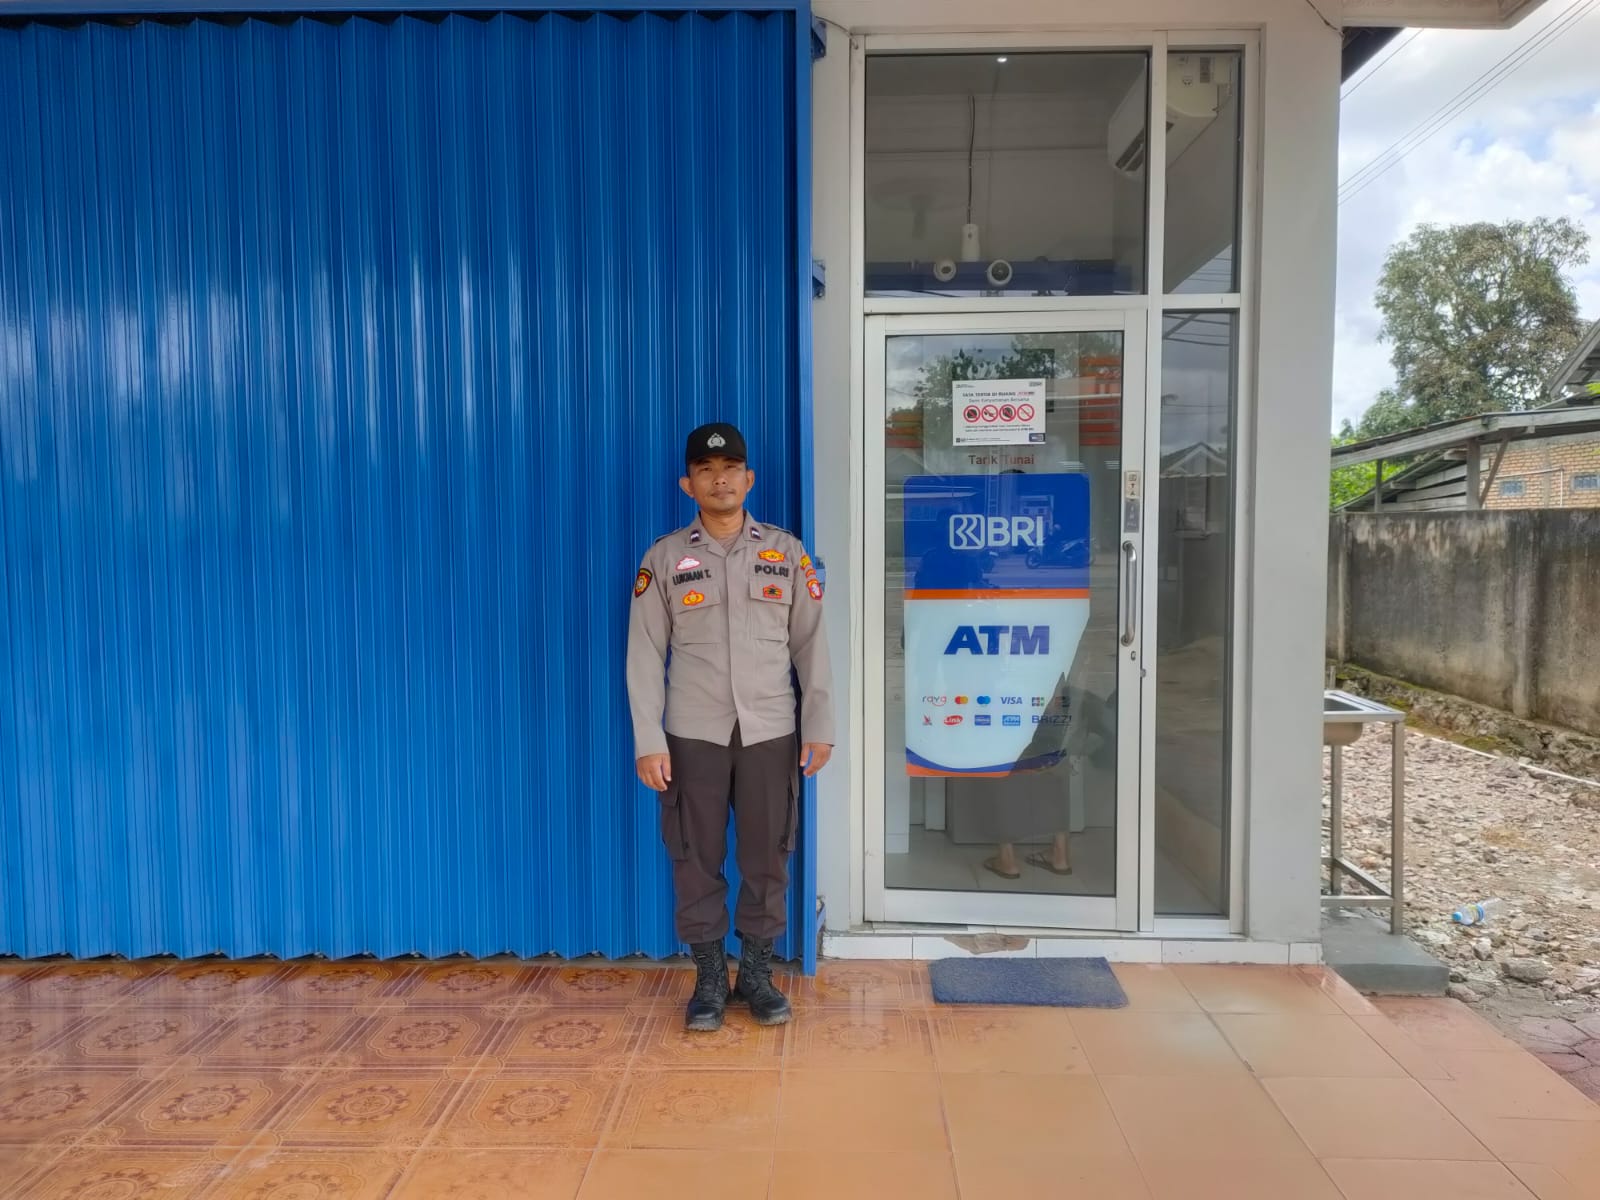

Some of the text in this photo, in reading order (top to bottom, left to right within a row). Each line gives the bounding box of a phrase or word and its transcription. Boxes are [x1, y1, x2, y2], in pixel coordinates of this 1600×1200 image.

[968, 453, 1034, 465] Tarik Tunai
[987, 516, 1043, 547] BRI
[704, 569, 711, 578] T.
[754, 564, 789, 577] POLRI
[943, 626, 1049, 655] ATM
[1000, 696, 1023, 705] VISA
